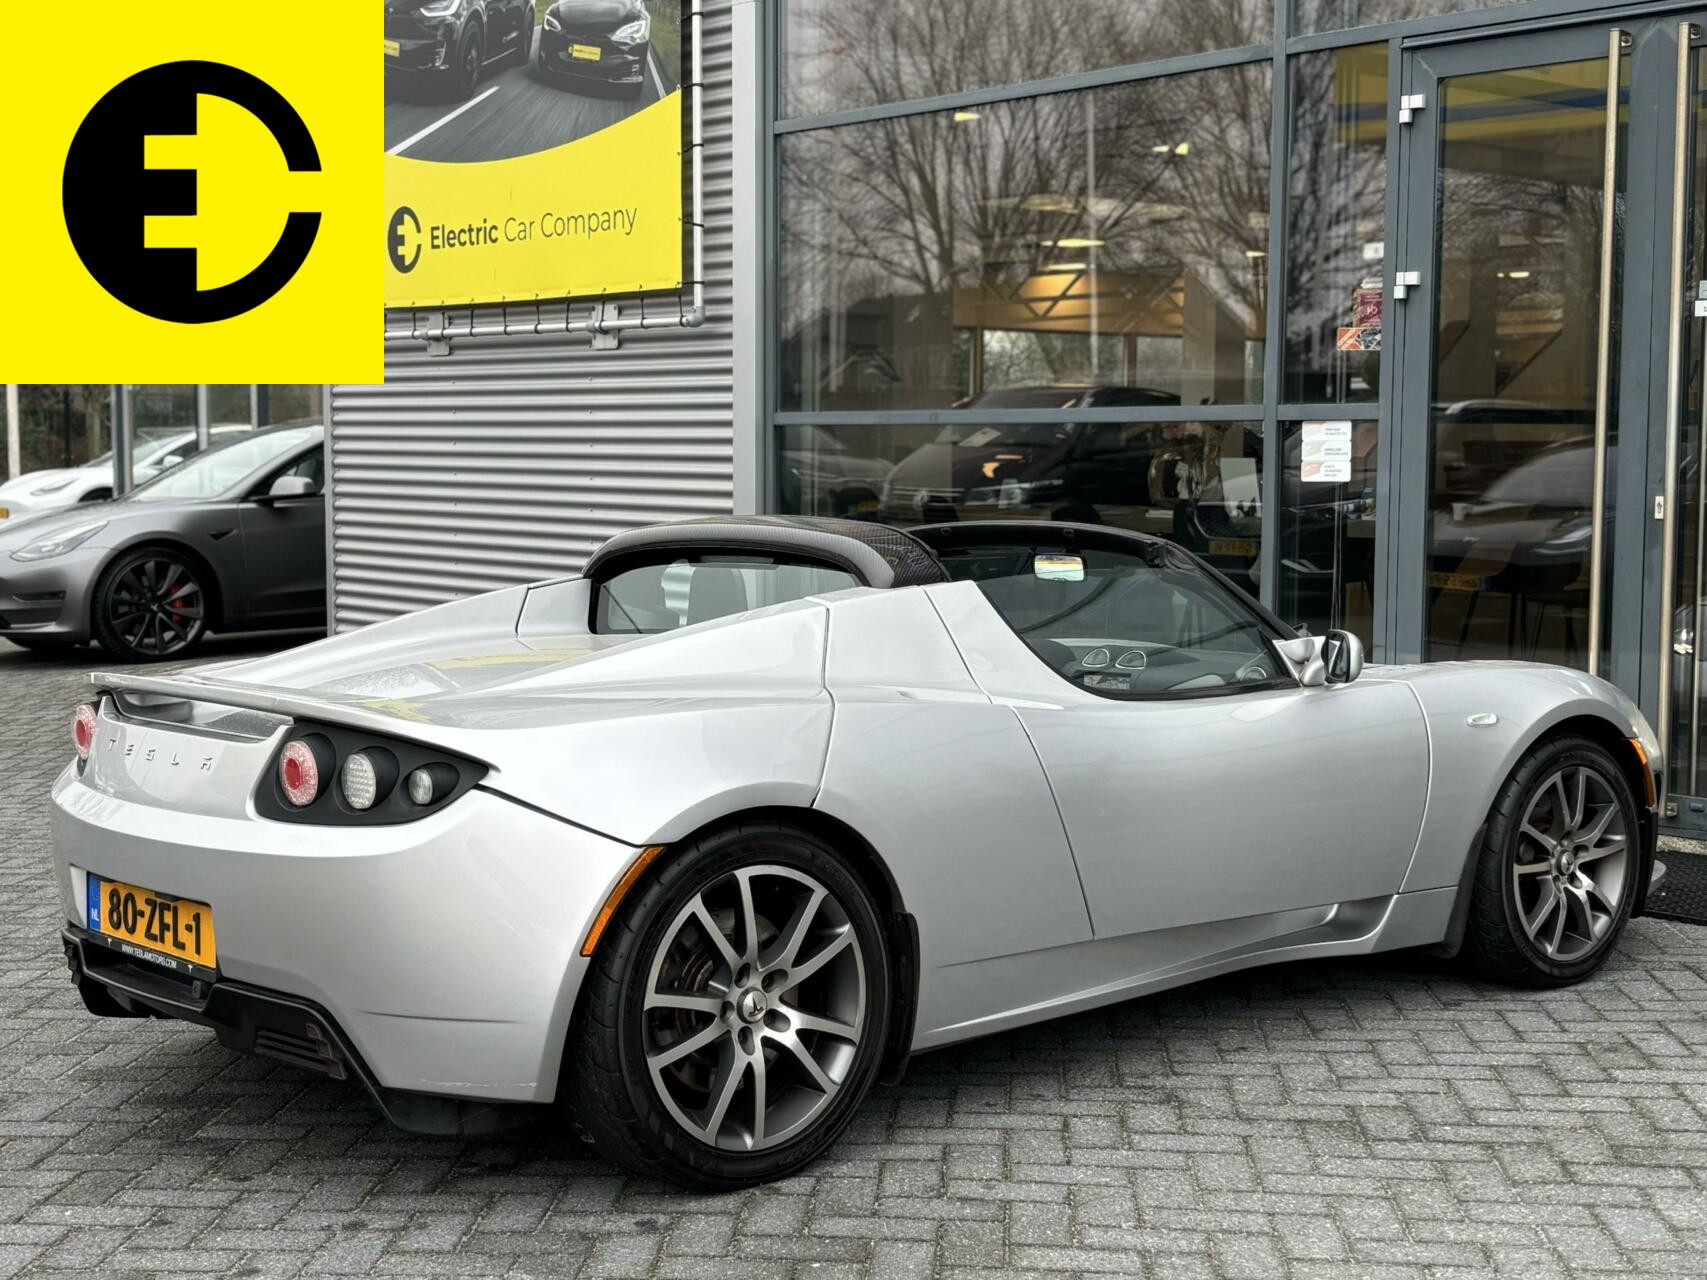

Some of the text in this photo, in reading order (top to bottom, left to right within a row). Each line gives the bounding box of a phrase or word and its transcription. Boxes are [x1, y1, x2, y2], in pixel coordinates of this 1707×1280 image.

[430, 208, 637, 250] Electric Car Company
[107, 738, 213, 771] TESLA
[90, 908, 100, 922] NL
[108, 887, 202, 958] 80-ZFL-1
[121, 943, 177, 969] WWW.TESLAMOTORS.COM
